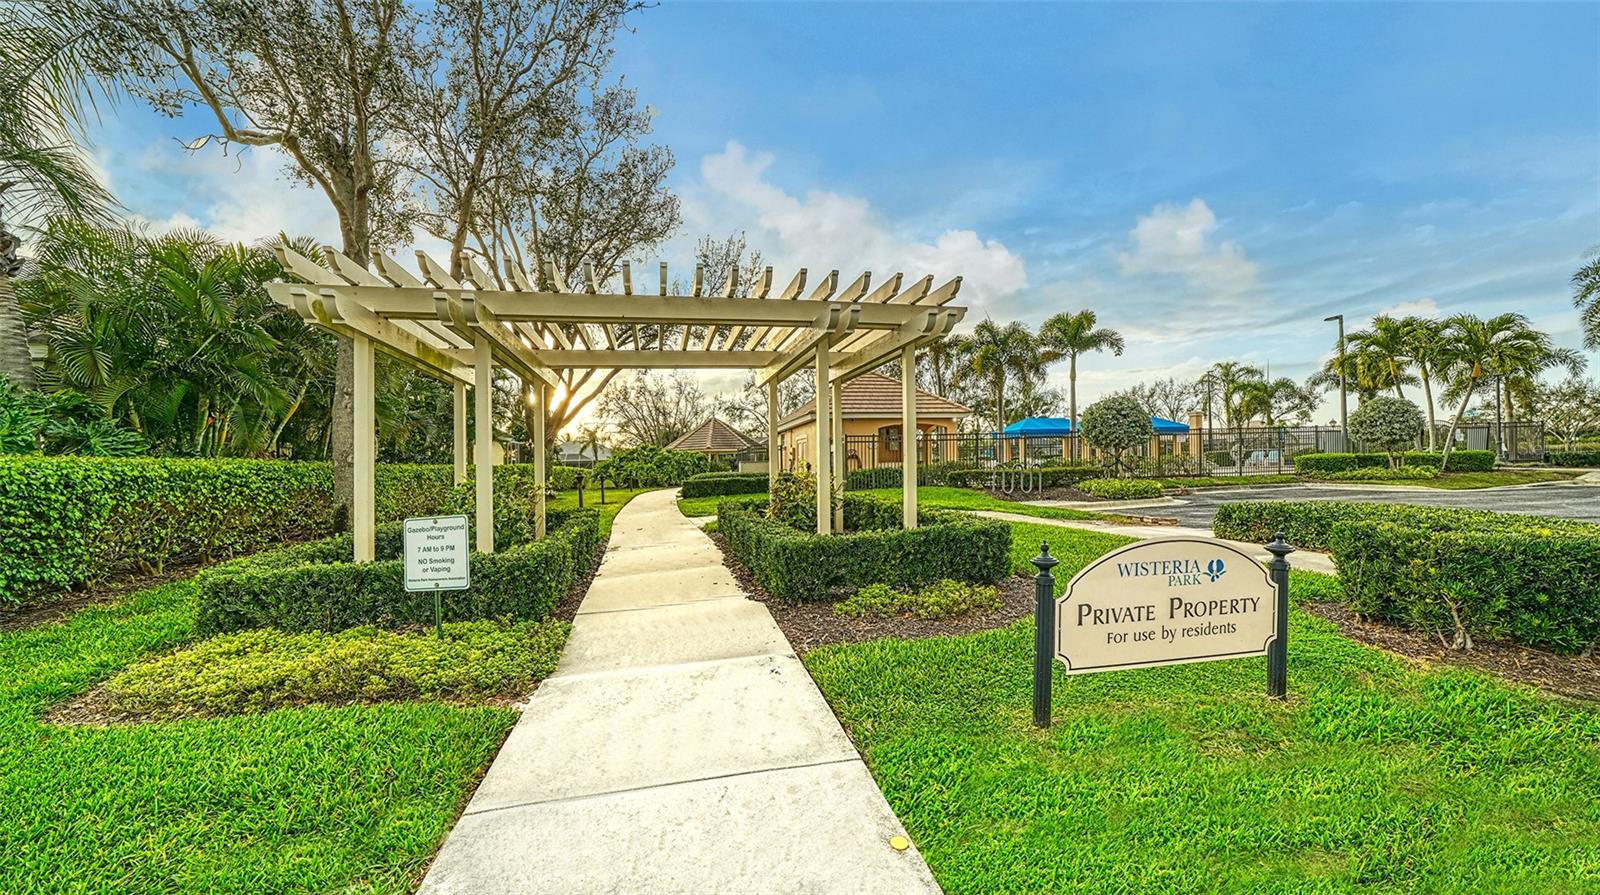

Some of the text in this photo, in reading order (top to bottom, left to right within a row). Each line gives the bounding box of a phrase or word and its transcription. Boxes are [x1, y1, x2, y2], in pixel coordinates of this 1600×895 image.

[407, 525, 464, 533] Gazebo/Playground
[1117, 560, 1200, 577] WISTERIA
[1168, 574, 1202, 587] PARK
[1107, 622, 1237, 644] For use by residents
